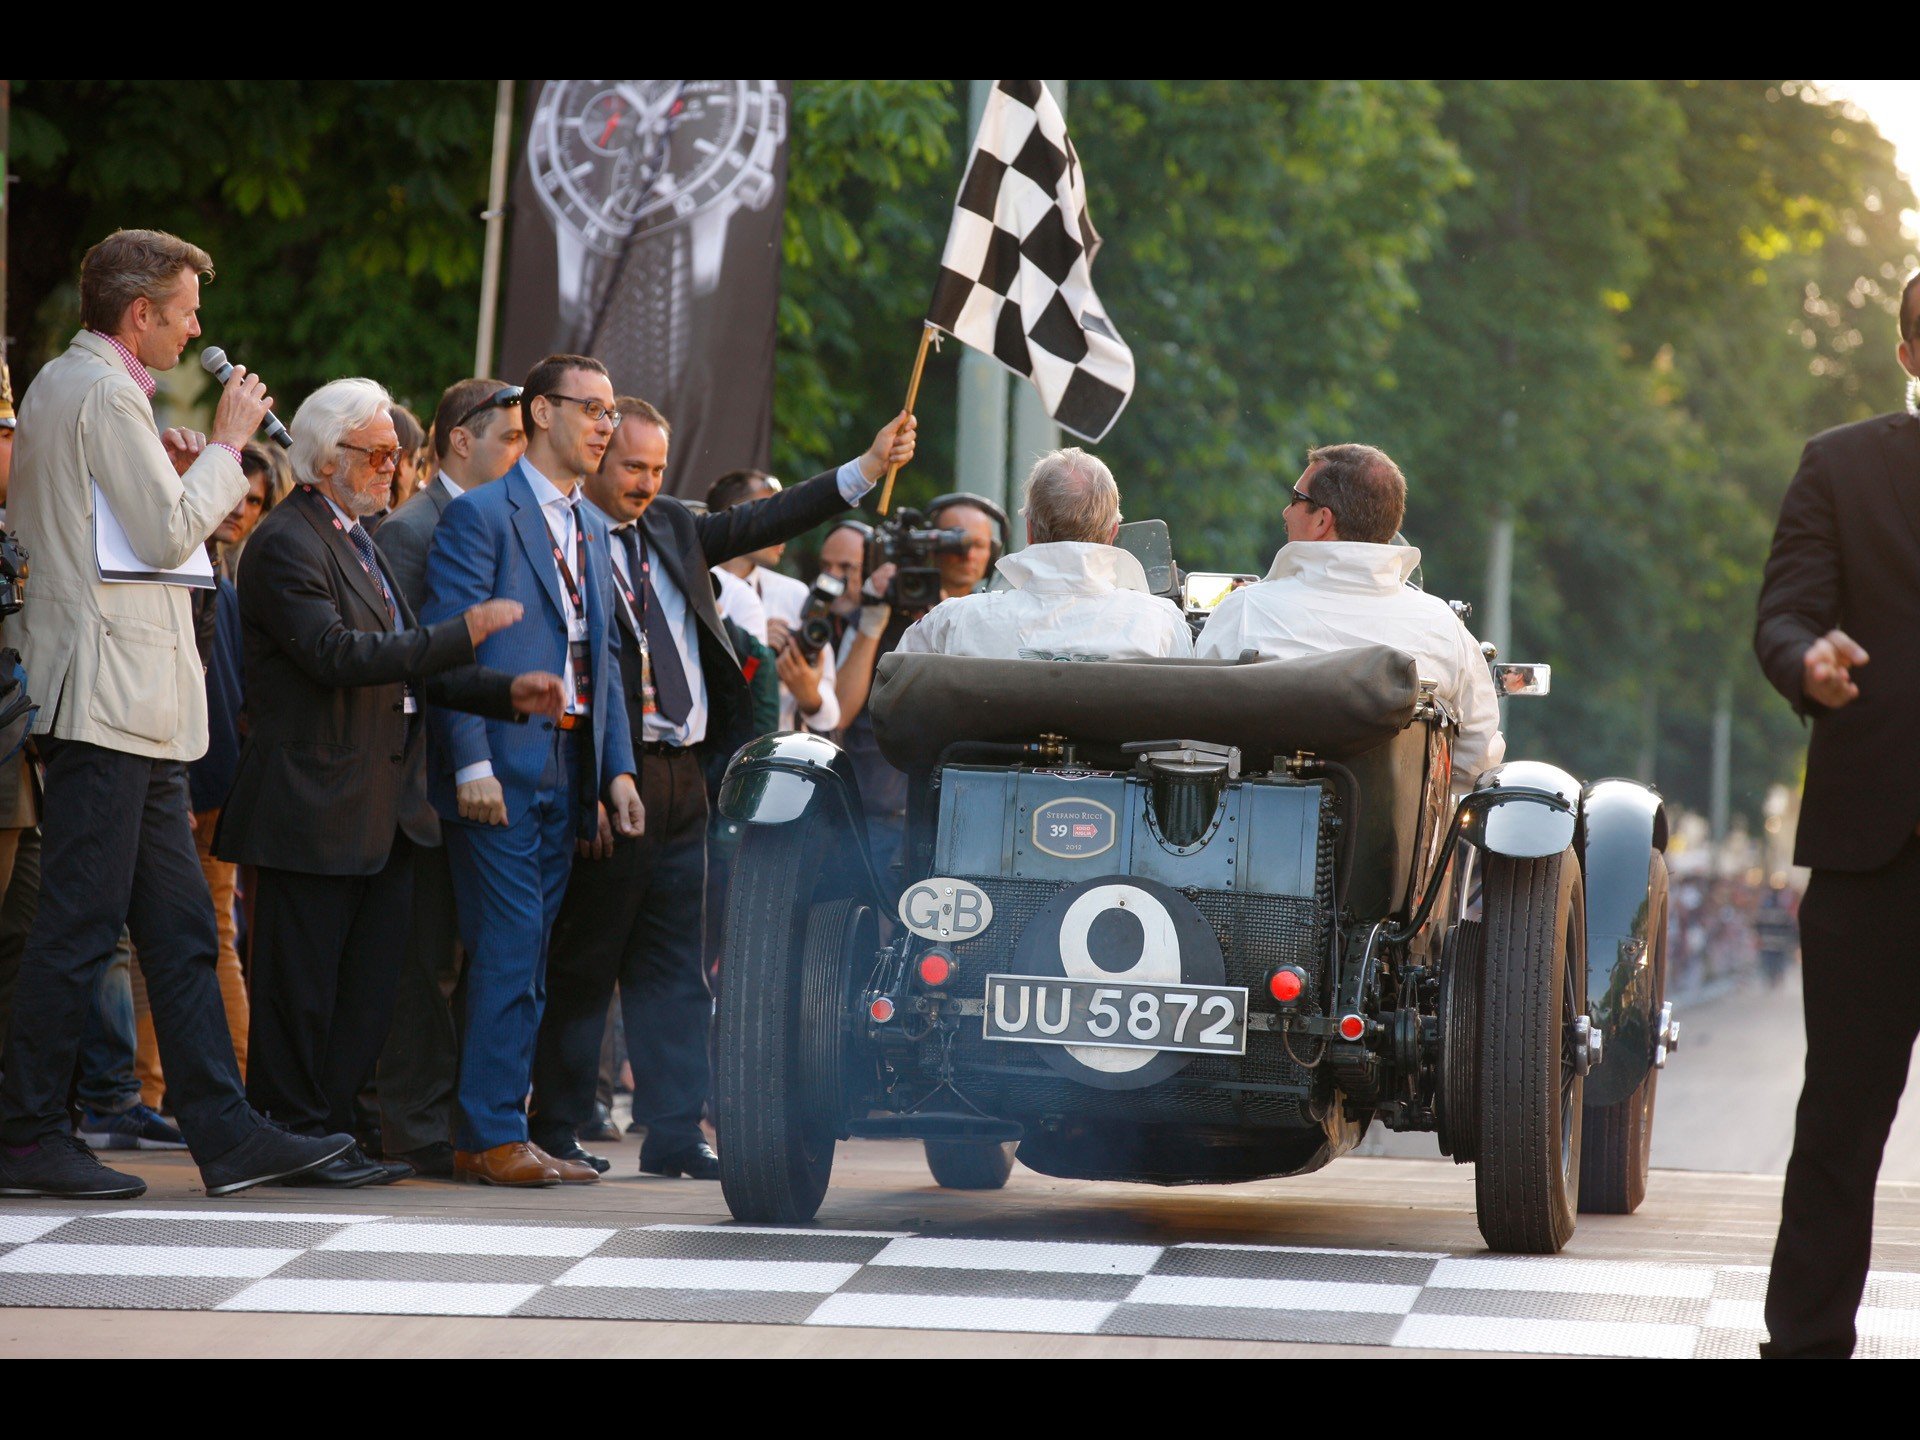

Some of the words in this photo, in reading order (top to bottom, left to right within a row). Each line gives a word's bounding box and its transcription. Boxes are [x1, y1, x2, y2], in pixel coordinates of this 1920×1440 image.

[1046, 811, 1080, 819] STEFANO
[1081, 811, 1103, 820] RICCI
[1050, 824, 1068, 837] 39
[905, 886, 983, 932] GB
[994, 985, 1071, 1034] UU
[1086, 988, 1235, 1044] 5872
